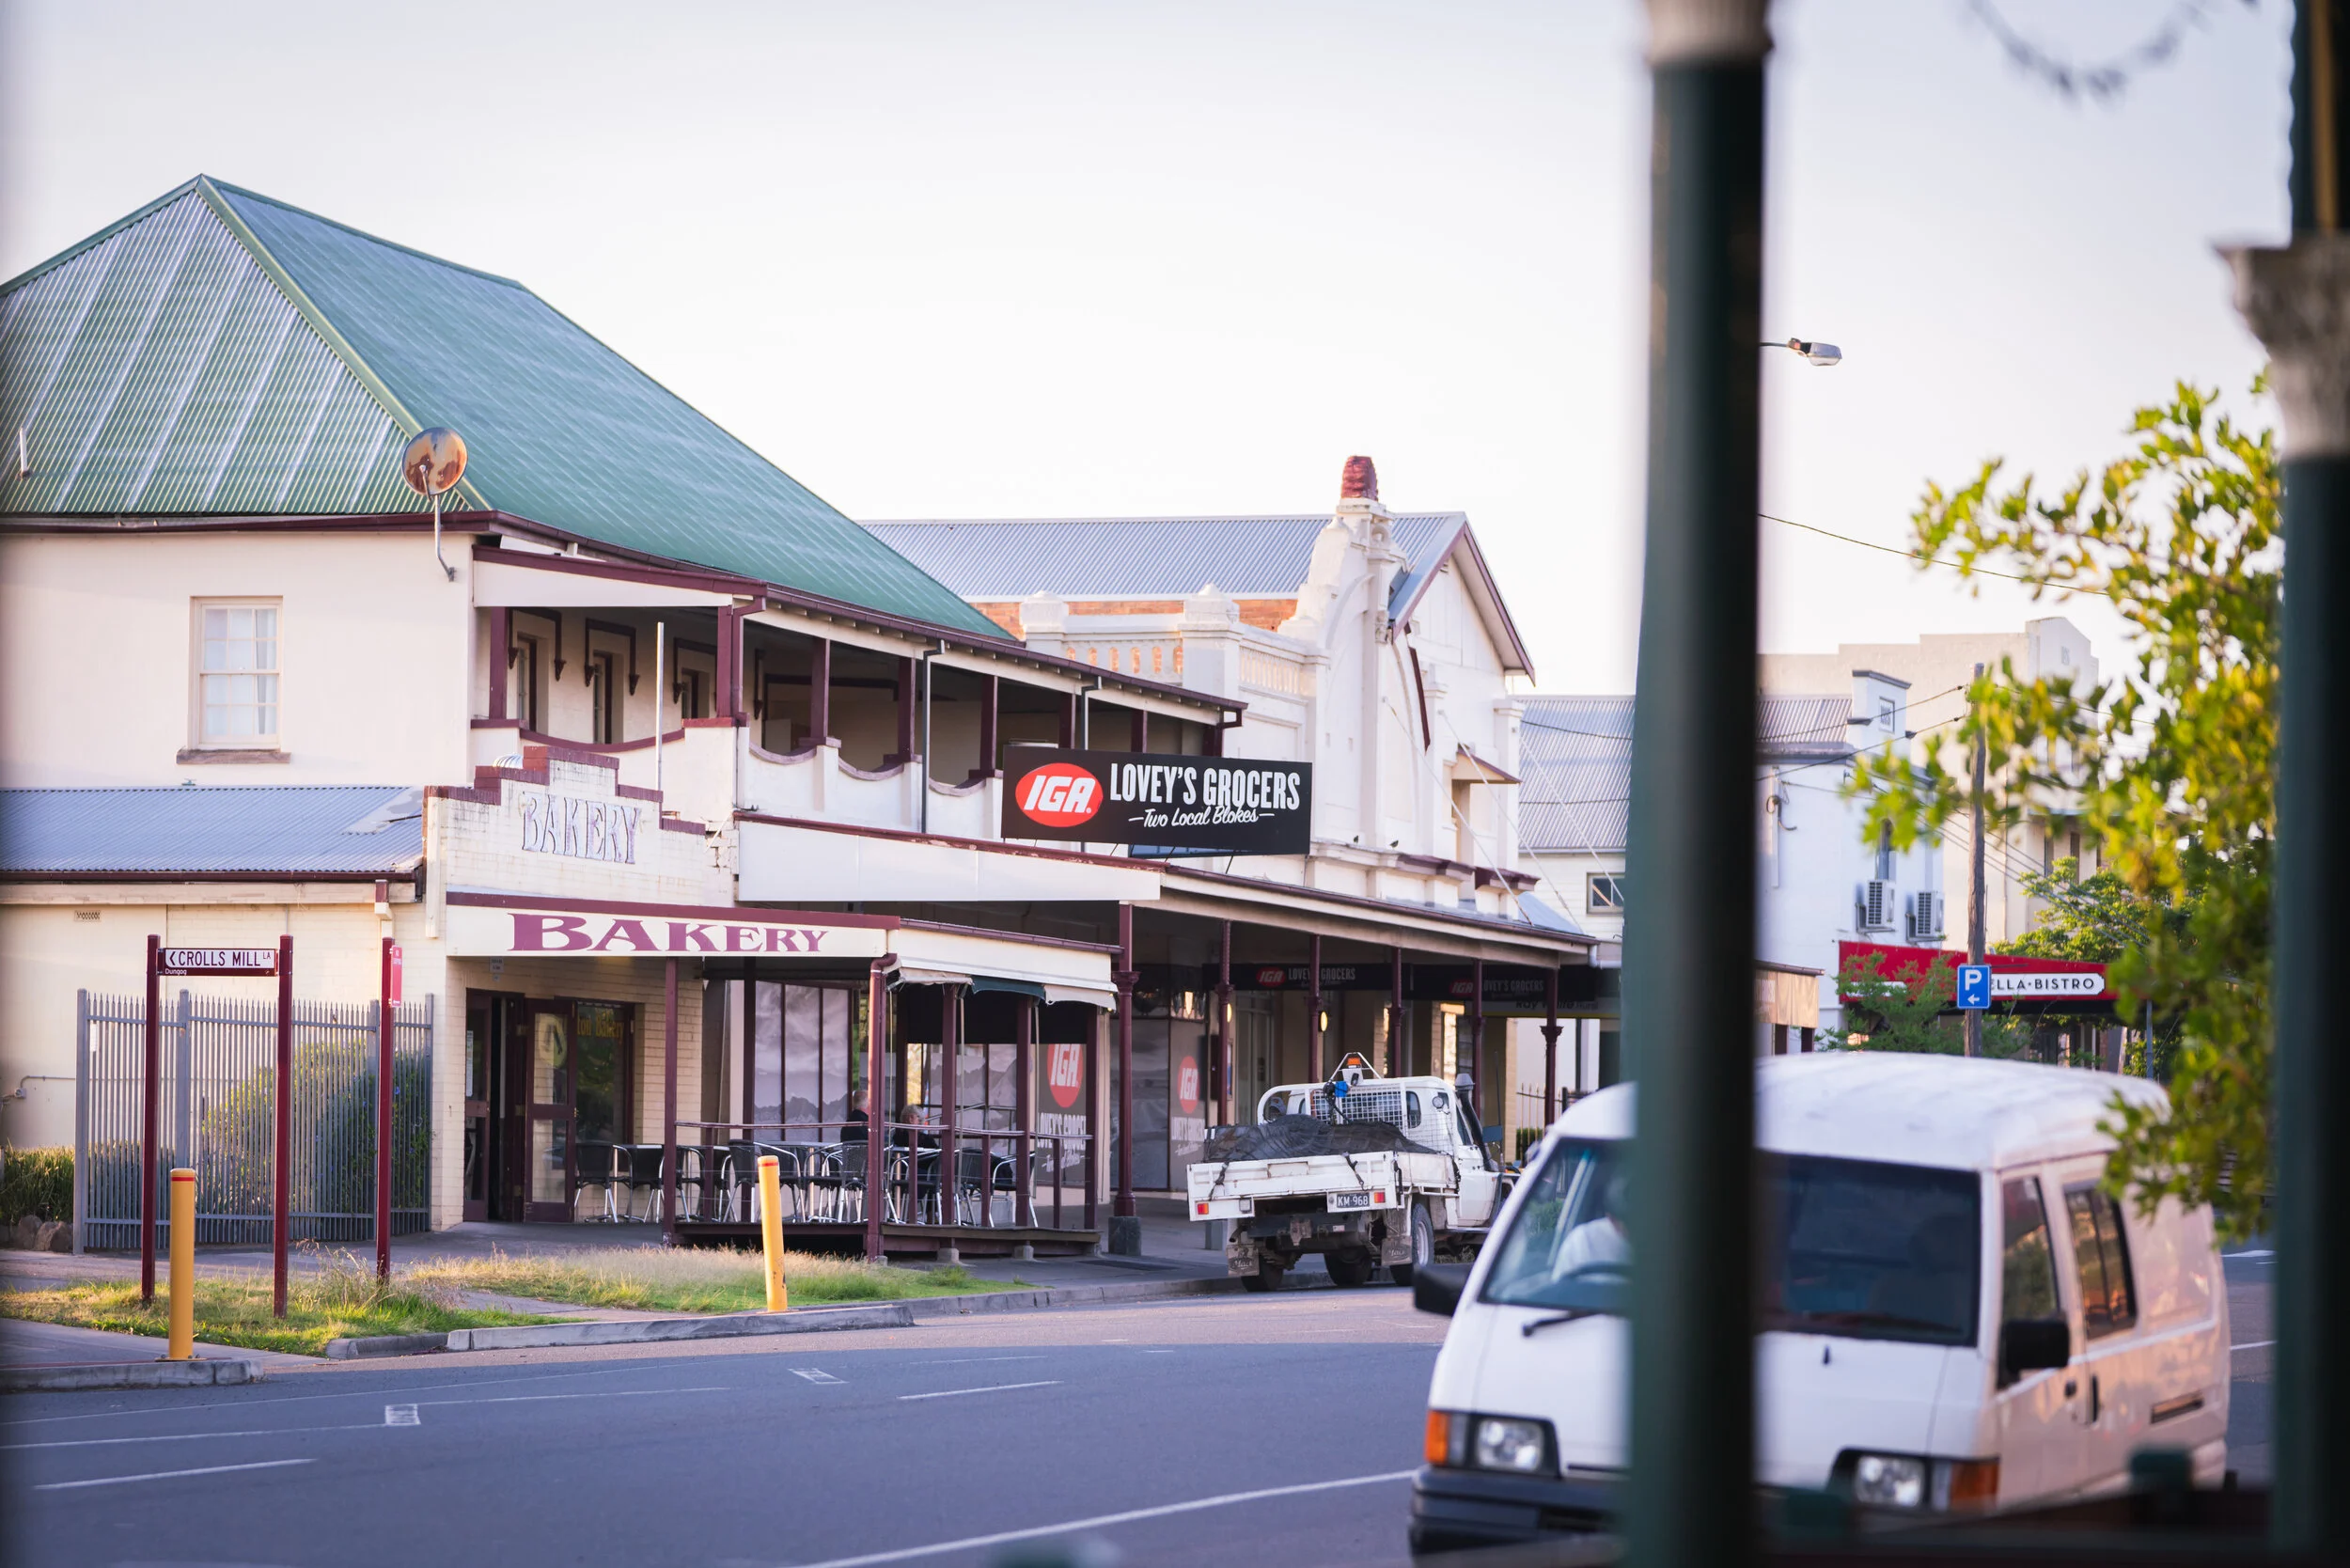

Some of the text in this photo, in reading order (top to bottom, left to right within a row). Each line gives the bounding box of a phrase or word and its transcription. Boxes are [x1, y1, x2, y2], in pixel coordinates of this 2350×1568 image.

[1024, 775, 1096, 814] IGA
[1110, 762, 1301, 811] LOVEY'S GROCERS
[522, 791, 642, 865] BAKERY
[1143, 805, 1260, 828] Two Local Blokes
[508, 912, 829, 953] BAKERY
[178, 950, 271, 966] CROLLS MILL LA
[1259, 970, 1284, 982] IGA
[1481, 980, 1509, 992] OVEY'S
[1965, 968, 1982, 991] P
[1049, 1043, 1081, 1088] IGA
